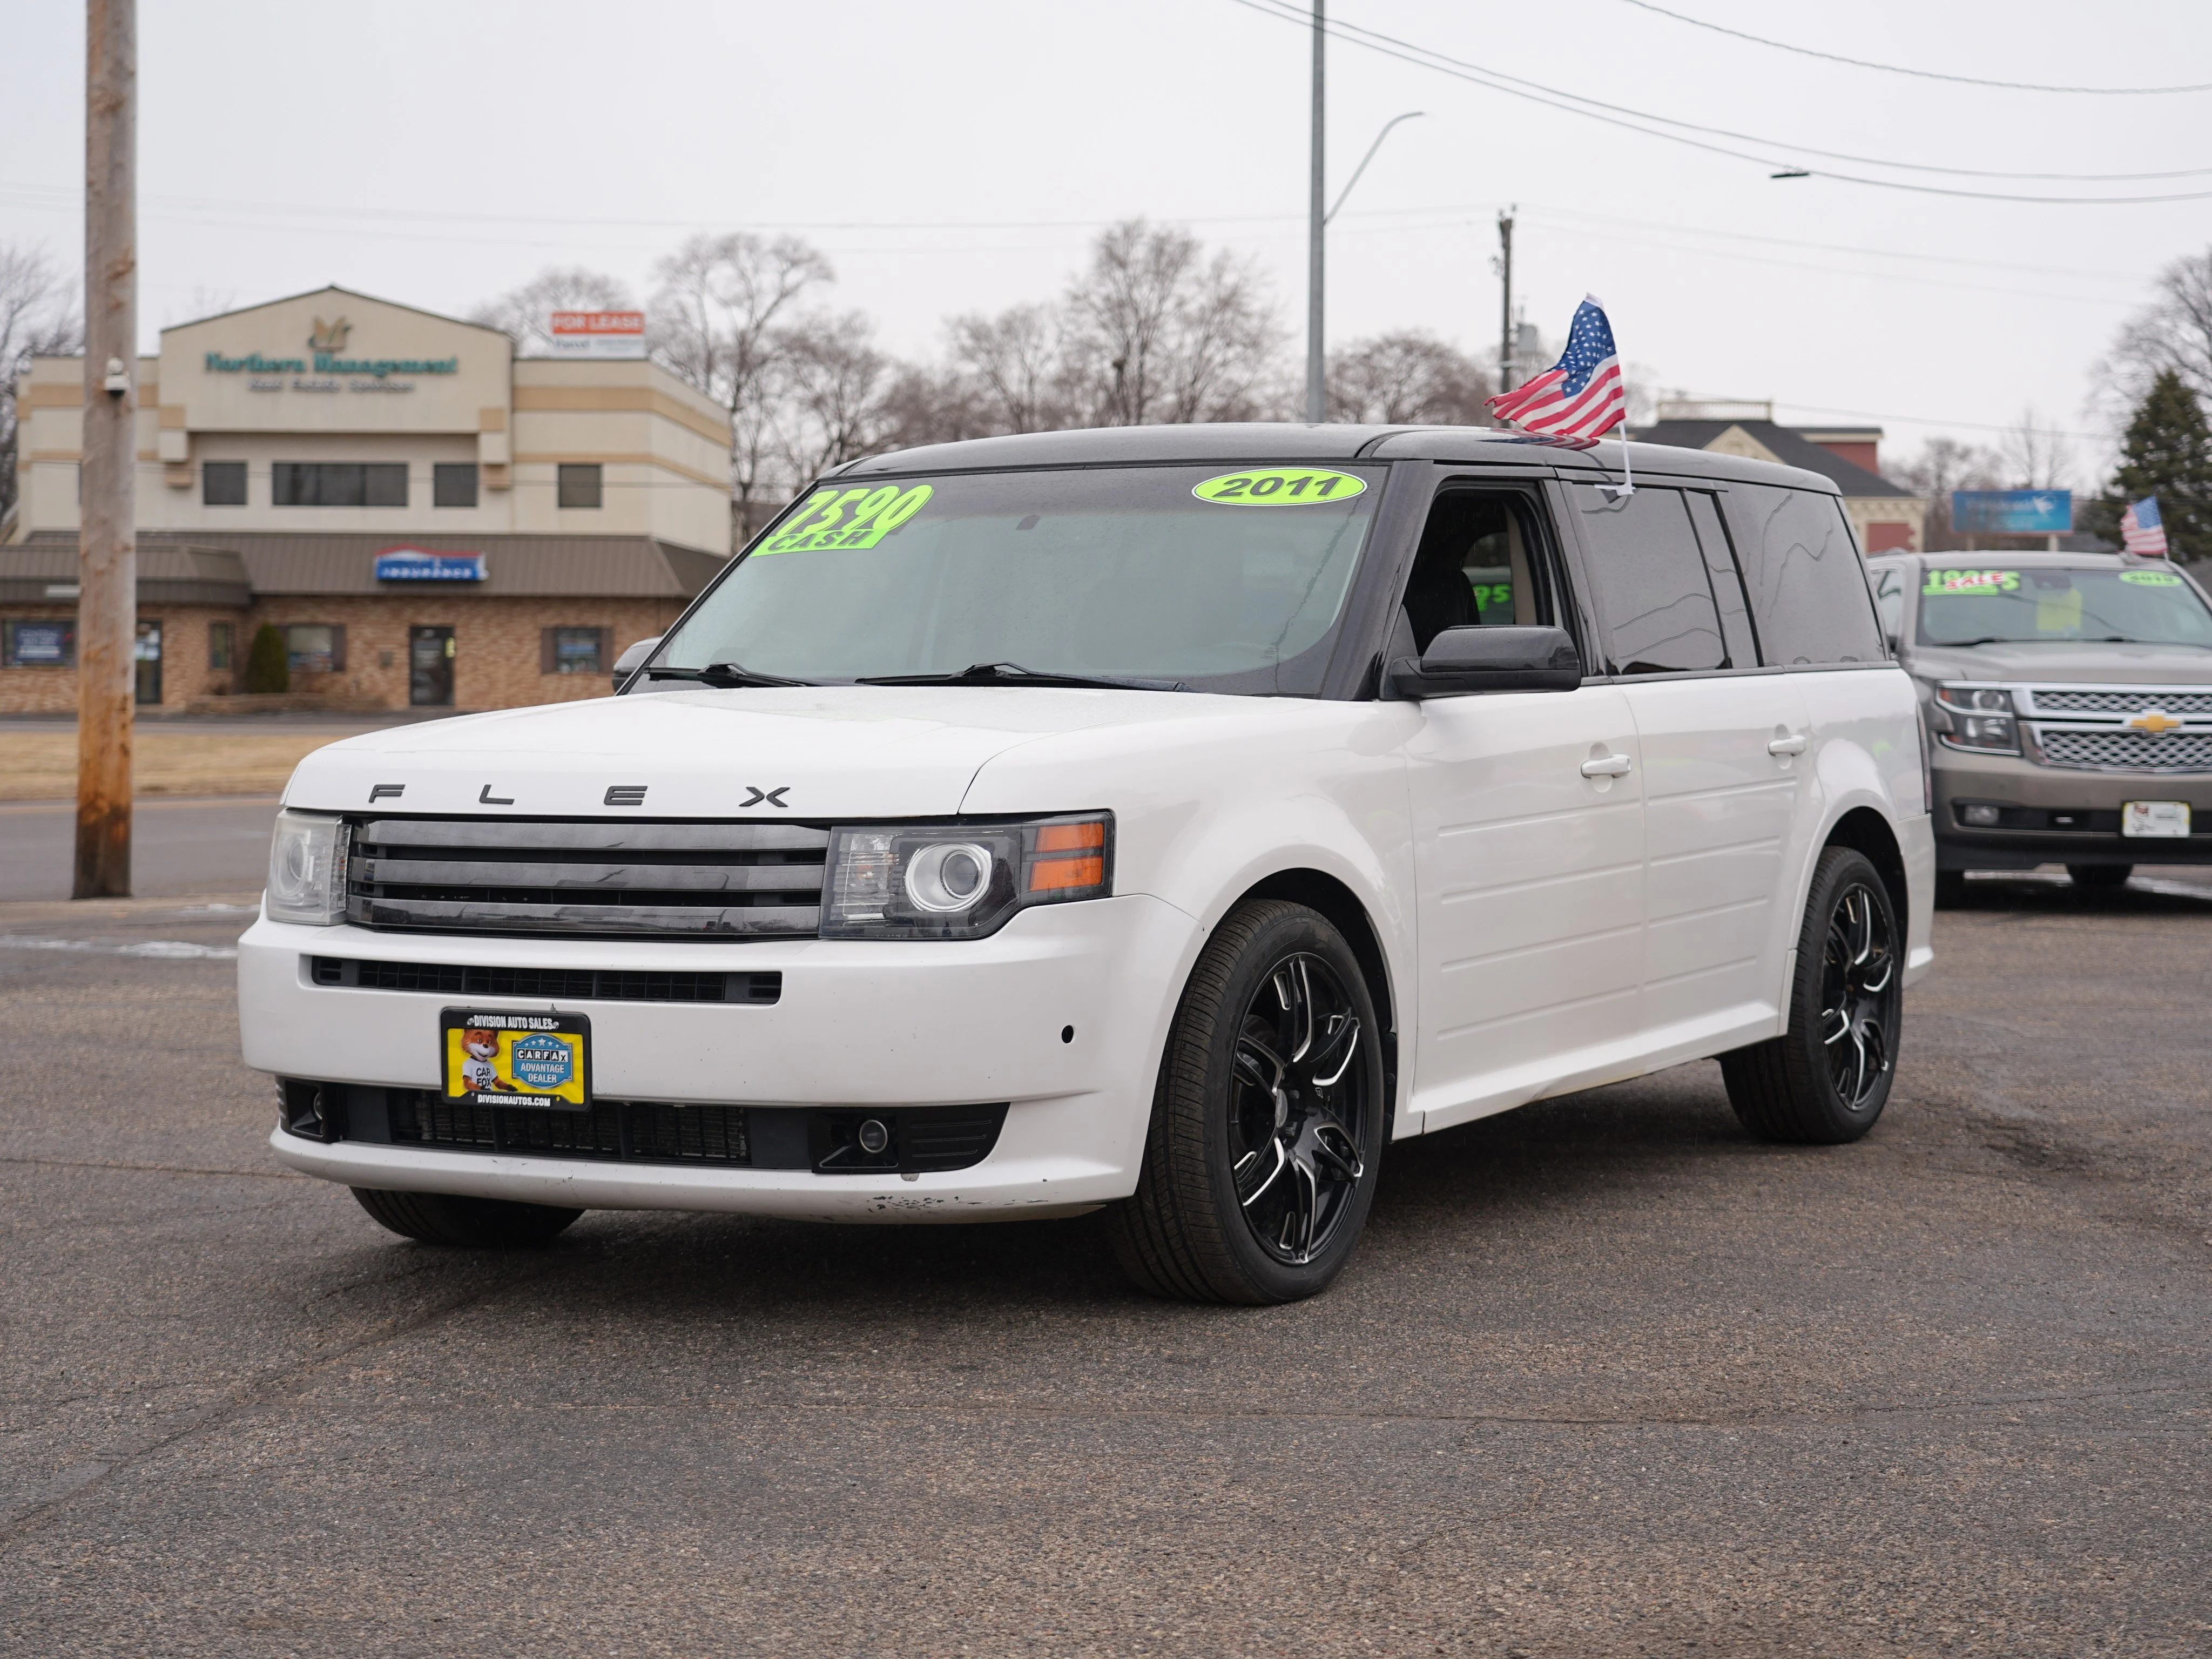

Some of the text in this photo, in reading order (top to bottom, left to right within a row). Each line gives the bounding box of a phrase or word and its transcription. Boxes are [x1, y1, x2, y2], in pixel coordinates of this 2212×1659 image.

[554, 314, 644, 331] FOR LEASE
[206, 352, 458, 377] Northern Management
[1212, 476, 1342, 498] 2011
[776, 484, 934, 537] 7590
[768, 530, 874, 552] CASH
[1945, 571, 2005, 592] SALE
[368, 783, 791, 807] FLEX
[474, 1015, 553, 1030] DIVISION AUTO SALES
[517, 1049, 568, 1062] CARFAX
[476, 1067, 491, 1077] CAR
[521, 1063, 565, 1074] ADVANTAGE
[477, 1077, 491, 1087] FOX
[528, 1073, 557, 1083] DEALER
[477, 1094, 551, 1107] DIVISIONAUTOS.COM
